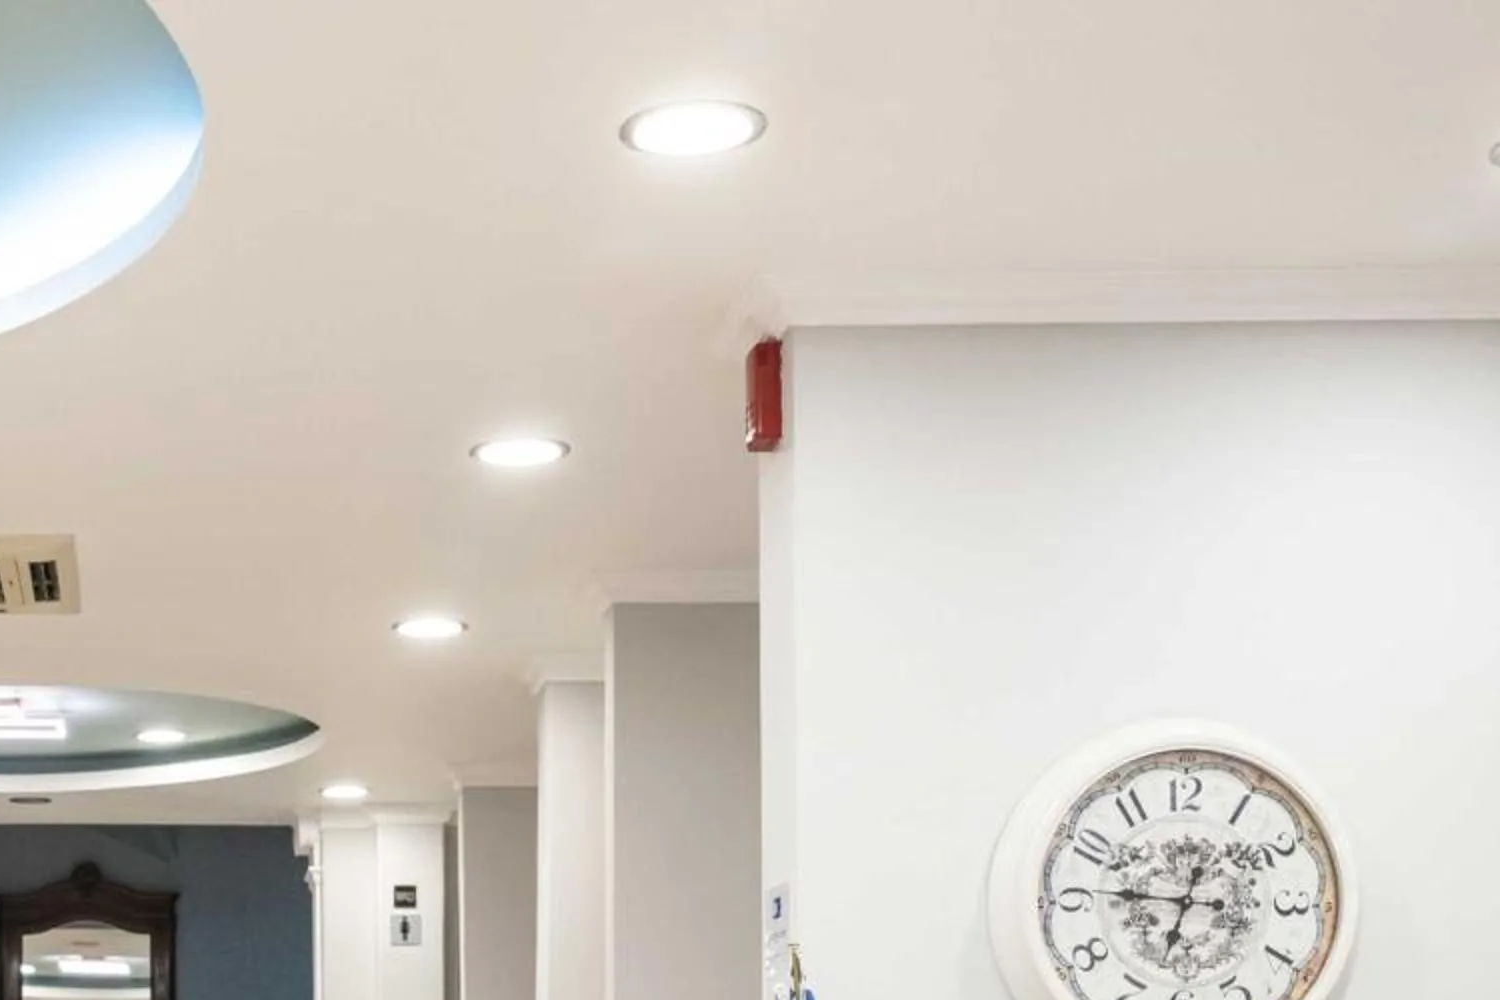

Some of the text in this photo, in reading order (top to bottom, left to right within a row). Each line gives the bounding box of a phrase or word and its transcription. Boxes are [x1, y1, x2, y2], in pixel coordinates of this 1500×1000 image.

[1115, 787, 1148, 828] 11
[1169, 776, 1202, 812] 12
[1228, 793, 1251, 825] 1
[1073, 828, 1111, 866] 10
[1259, 831, 1296, 869] 2
[1059, 887, 1094, 913] 9
[1274, 889, 1310, 916] 3
[1072, 937, 1109, 972] 8
[1264, 944, 1294, 976] 4
